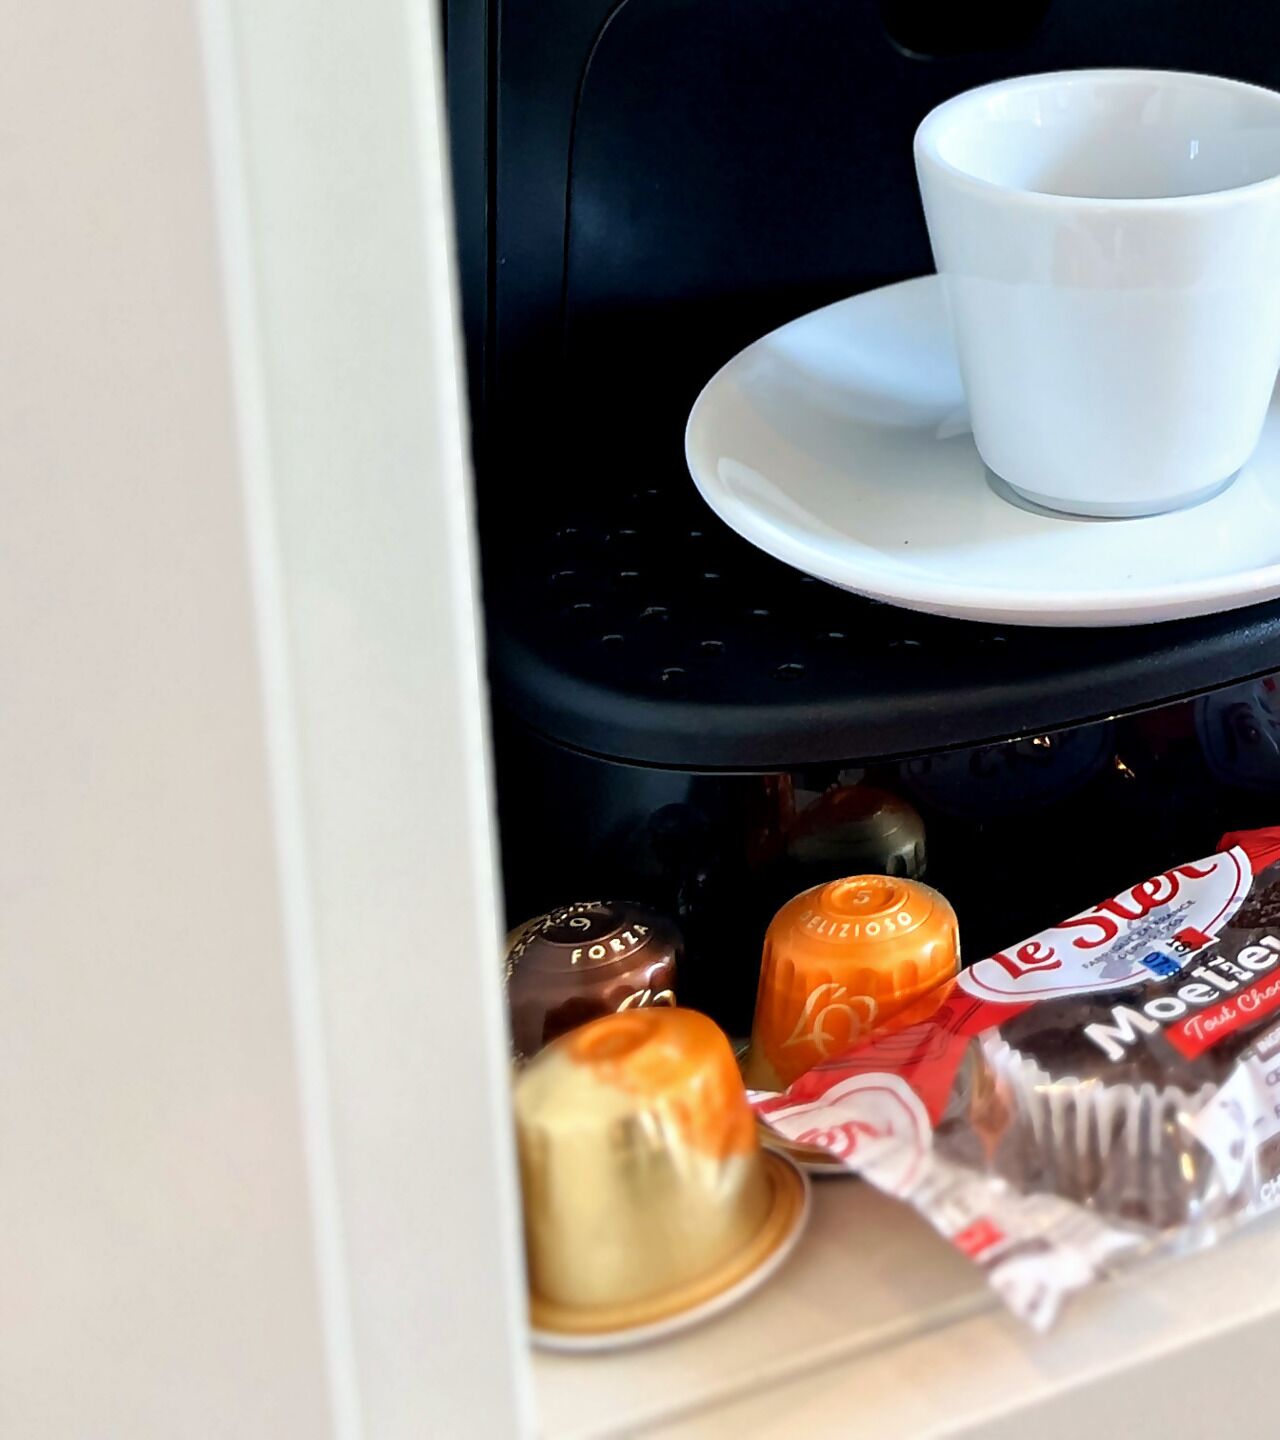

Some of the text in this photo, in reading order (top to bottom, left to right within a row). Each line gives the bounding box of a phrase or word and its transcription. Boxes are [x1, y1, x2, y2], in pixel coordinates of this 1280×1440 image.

[800, 910, 912, 938] DELIZIOSO
[571, 924, 648, 965] FORZA
[989, 941, 1062, 980] Le
[1184, 1006, 1236, 1040] Tout
